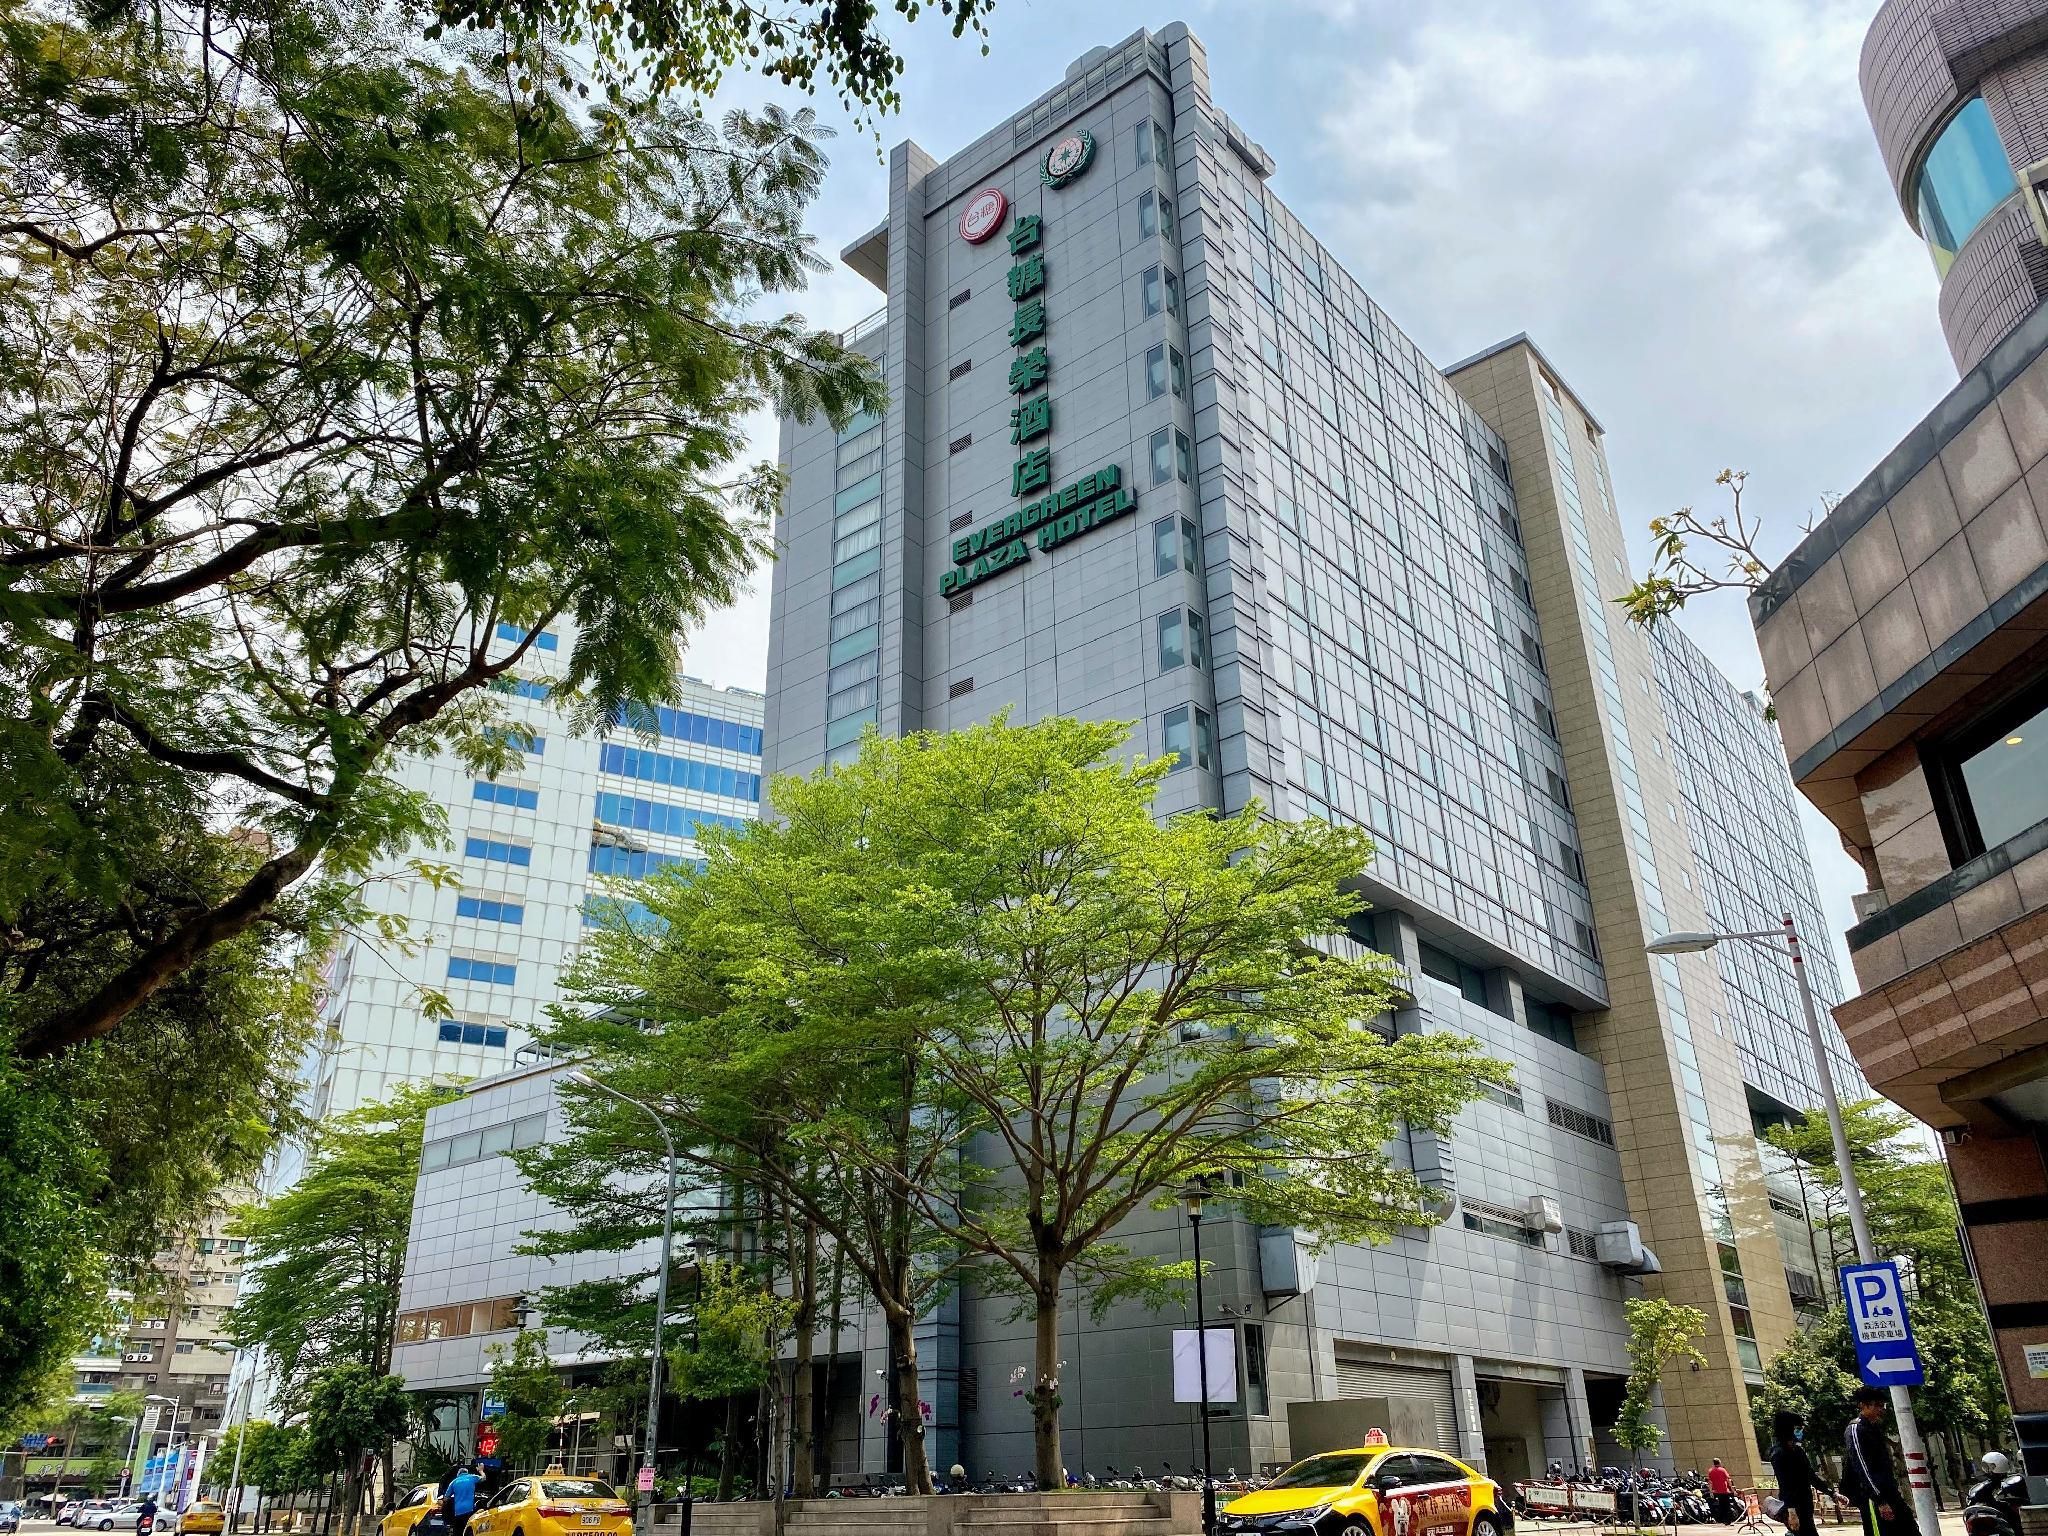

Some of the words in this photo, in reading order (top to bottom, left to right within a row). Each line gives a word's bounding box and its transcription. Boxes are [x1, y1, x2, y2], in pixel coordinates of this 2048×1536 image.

[1006, 214, 1050, 497] 台糖長榮酒店
[940, 539, 1031, 598] PLAZA
[1038, 487, 1137, 554] HOTEL
[953, 464, 1121, 567] EVERGREEN
[1854, 1275, 1887, 1319] P
